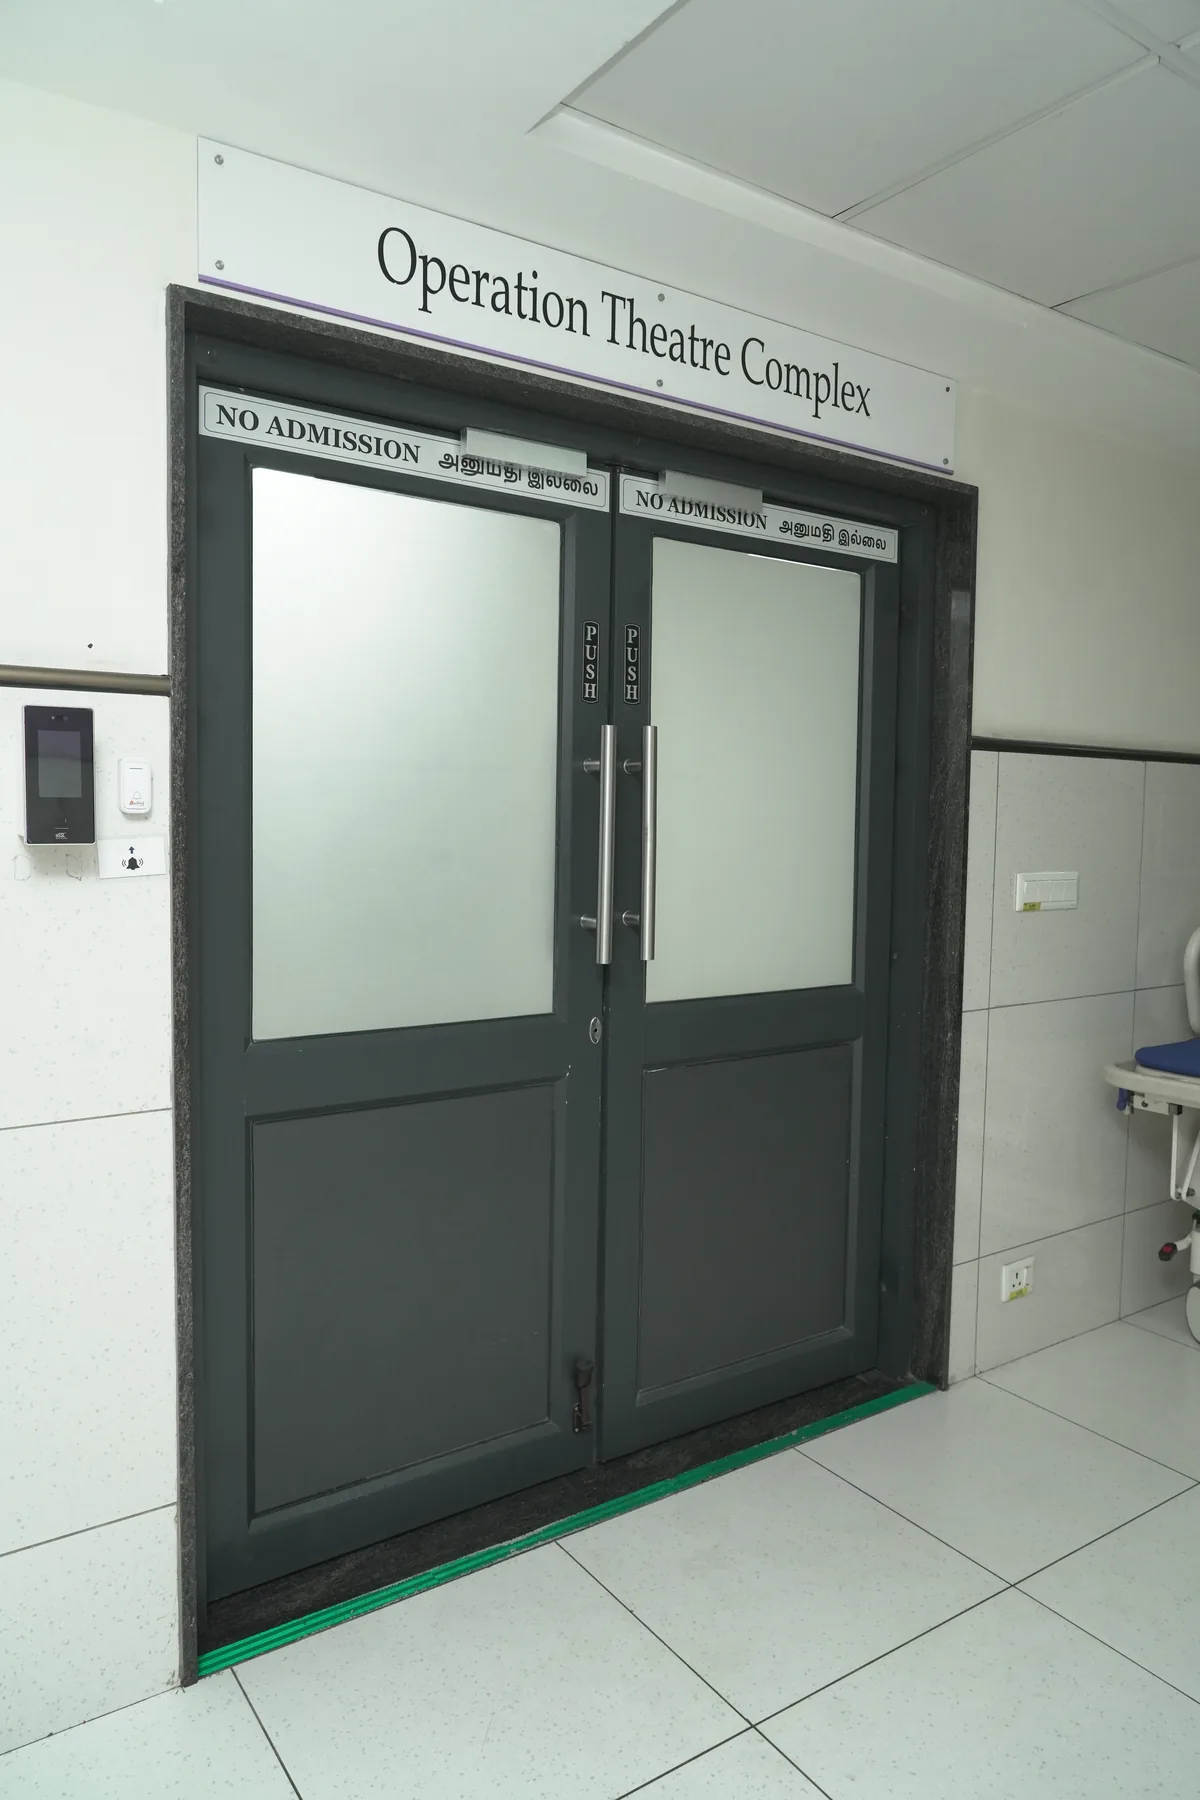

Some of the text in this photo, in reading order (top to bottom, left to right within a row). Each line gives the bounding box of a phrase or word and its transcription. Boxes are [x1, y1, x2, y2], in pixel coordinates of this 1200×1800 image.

[378, 227, 871, 420] Operation Theatre Complex
[215, 404, 421, 464] NO ADMISSION
[635, 489, 768, 530] NO ADMISSION
[779, 520, 887, 551] அனுமதி இல்லை
[584, 625, 597, 699] PUSH
[626, 628, 639, 700] PUSH
